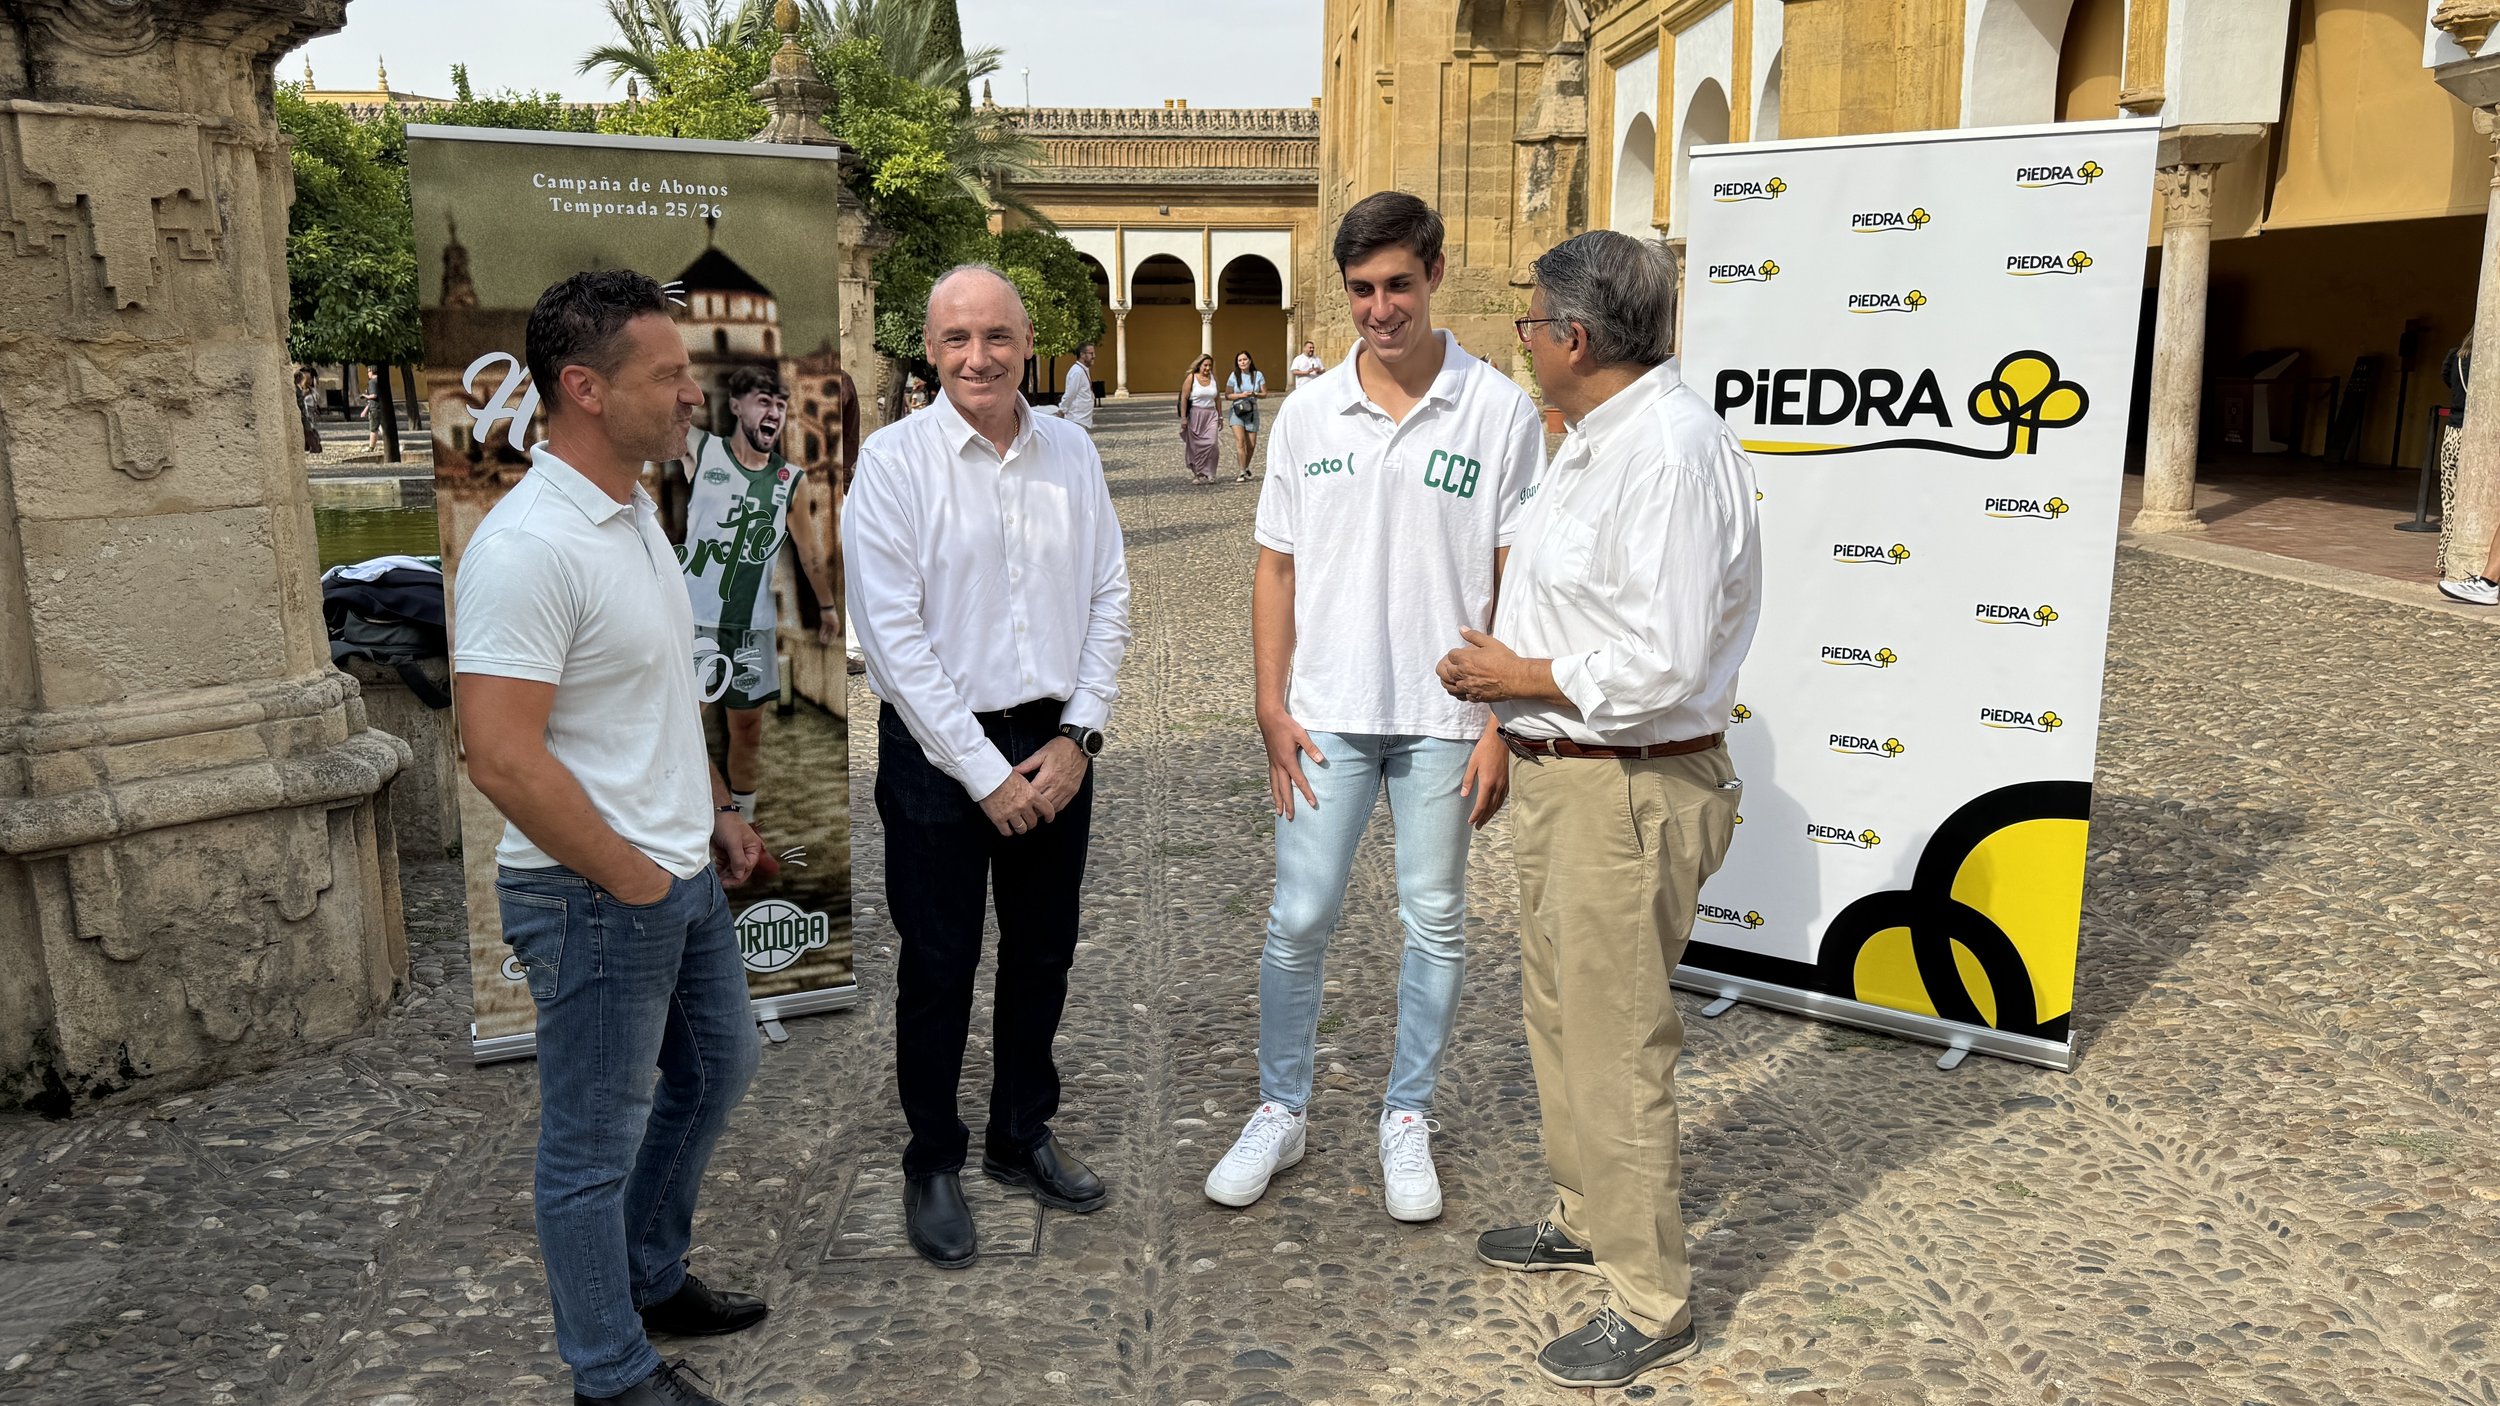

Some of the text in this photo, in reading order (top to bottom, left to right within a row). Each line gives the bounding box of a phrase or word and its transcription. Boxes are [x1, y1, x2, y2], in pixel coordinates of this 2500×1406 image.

[532, 173, 729, 197] Campaña de Abonos
[549, 197, 722, 218] Temporada 25/26
[1423, 449, 1481, 499] CCB
